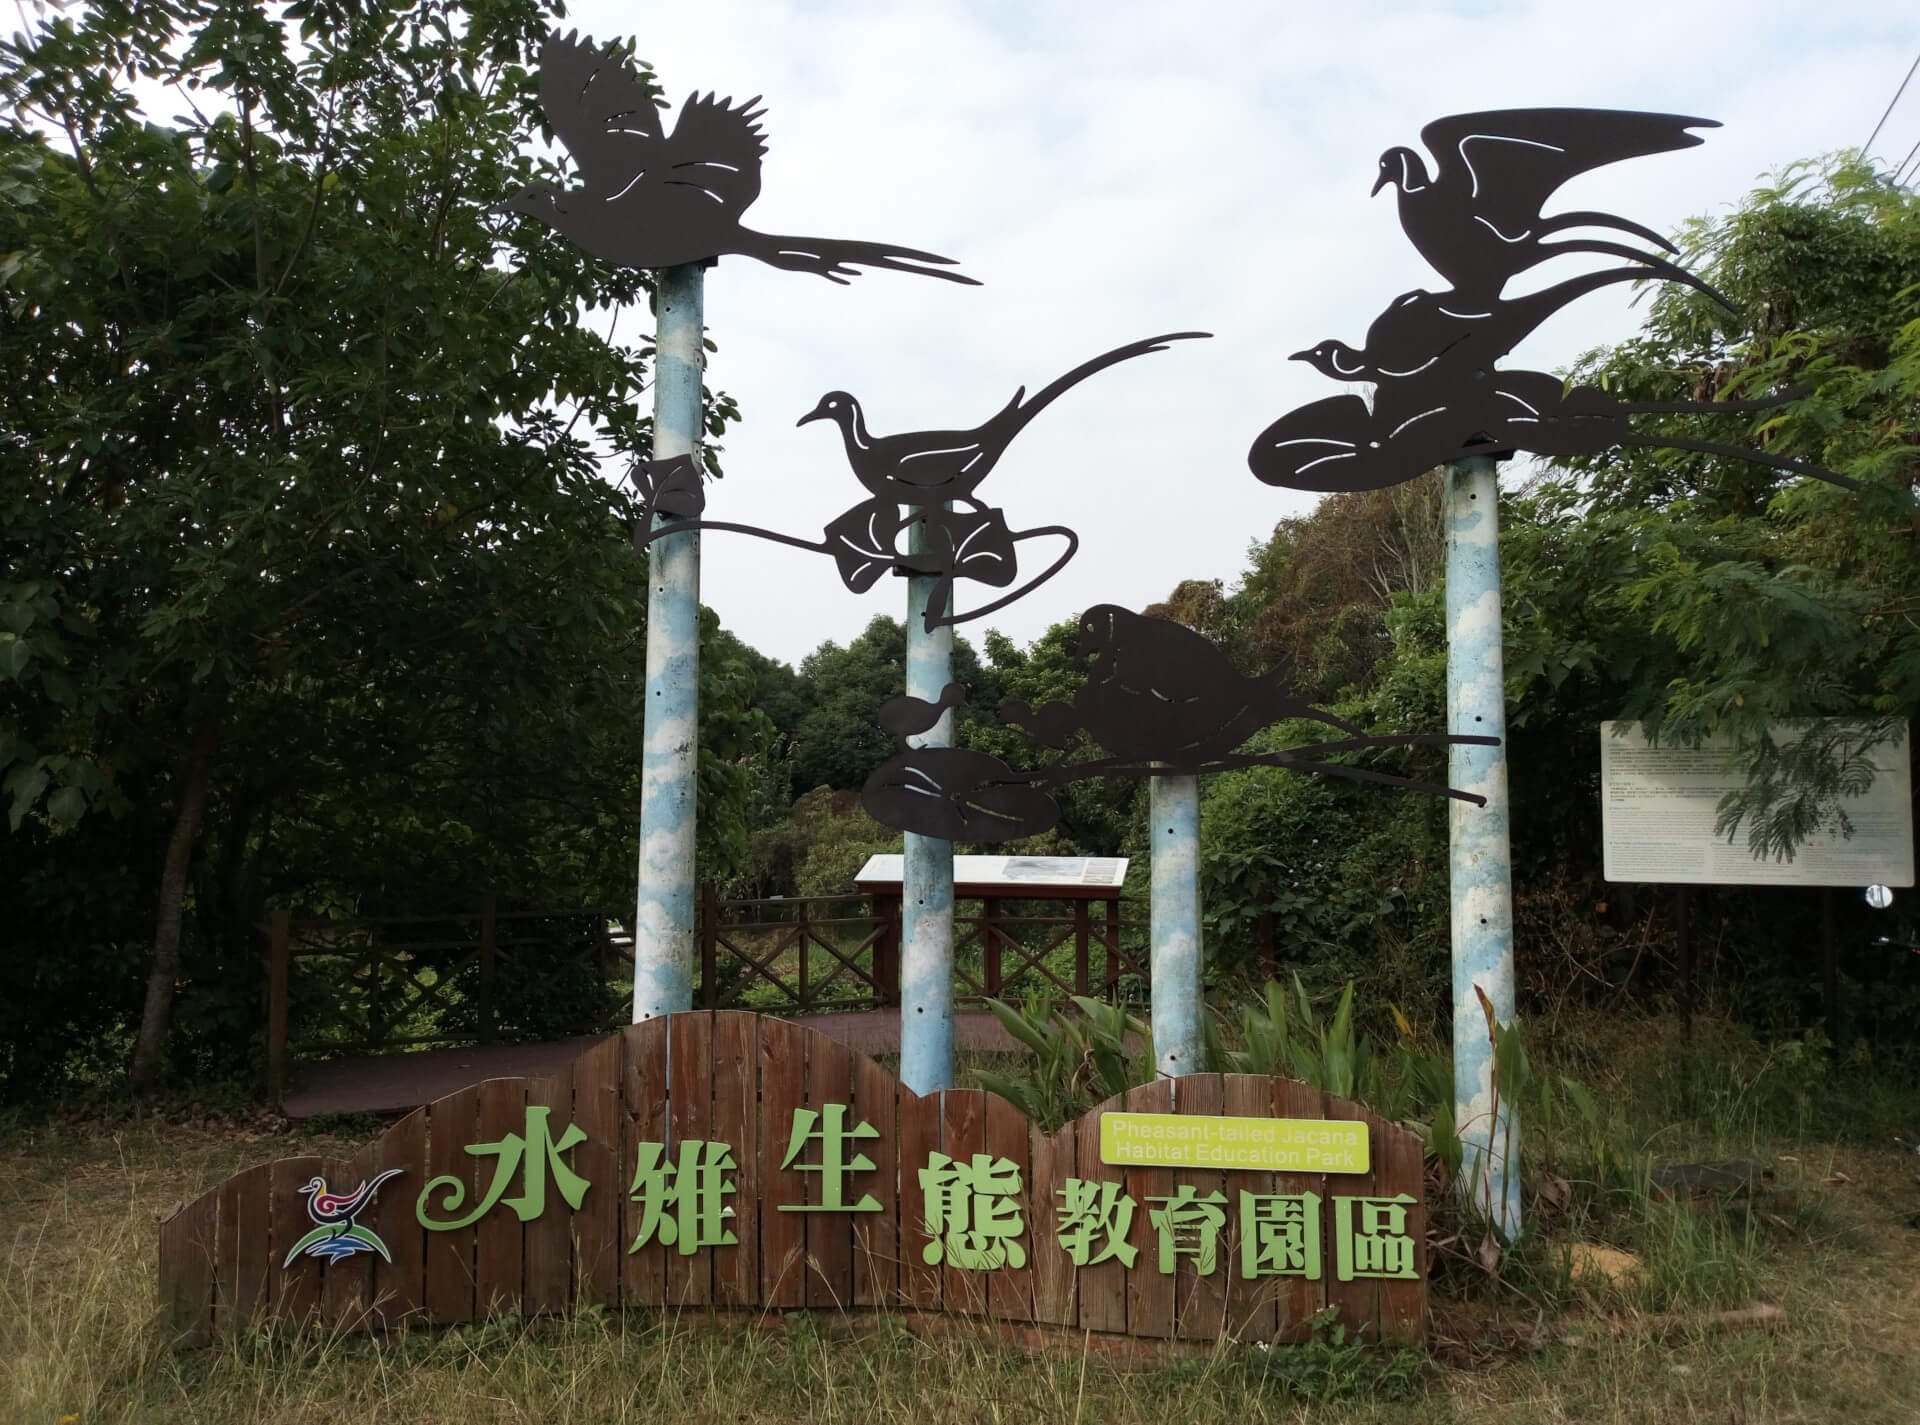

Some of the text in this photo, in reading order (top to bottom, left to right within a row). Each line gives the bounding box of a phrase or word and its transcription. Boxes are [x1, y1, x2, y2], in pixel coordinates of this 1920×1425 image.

[1112, 1119, 1359, 1146] Pheasant-tailed Jacana
[1116, 1140, 1356, 1168] Habitat Education Park
[416, 1104, 1420, 1282] 水雉生態教育園區
